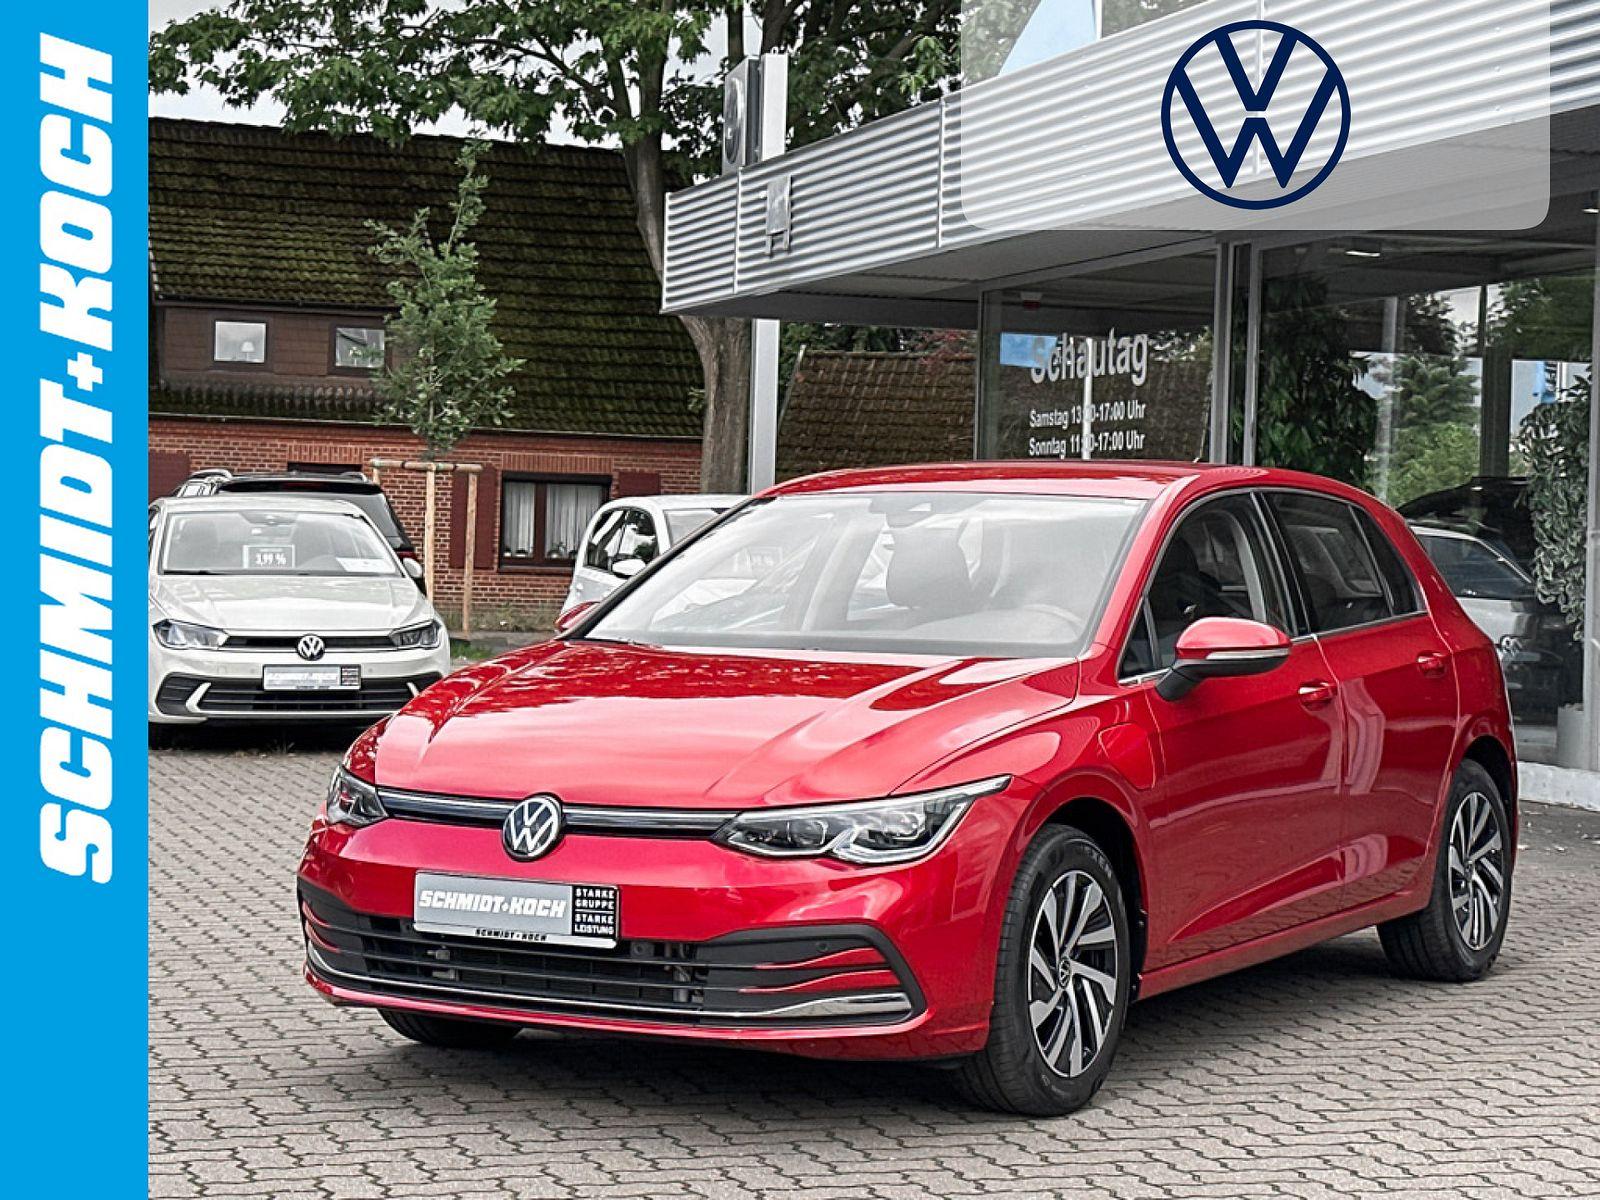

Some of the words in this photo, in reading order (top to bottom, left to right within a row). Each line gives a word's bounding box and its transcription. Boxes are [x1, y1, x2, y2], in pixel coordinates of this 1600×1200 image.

[1029, 409, 1069, 429] Samstag
[1071, 401, 1125, 424] 130-17:00
[1127, 399, 1147, 419] Uhr
[1029, 436, 1067, 460] Sonntag
[1070, 431, 1124, 453] 110-17:00
[1125, 429, 1146, 450] Uhr
[502, 794, 562, 861] VW
[574, 888, 615, 900] STARKE
[574, 899, 615, 910] GRUPPE
[574, 913, 615, 925] STARKE
